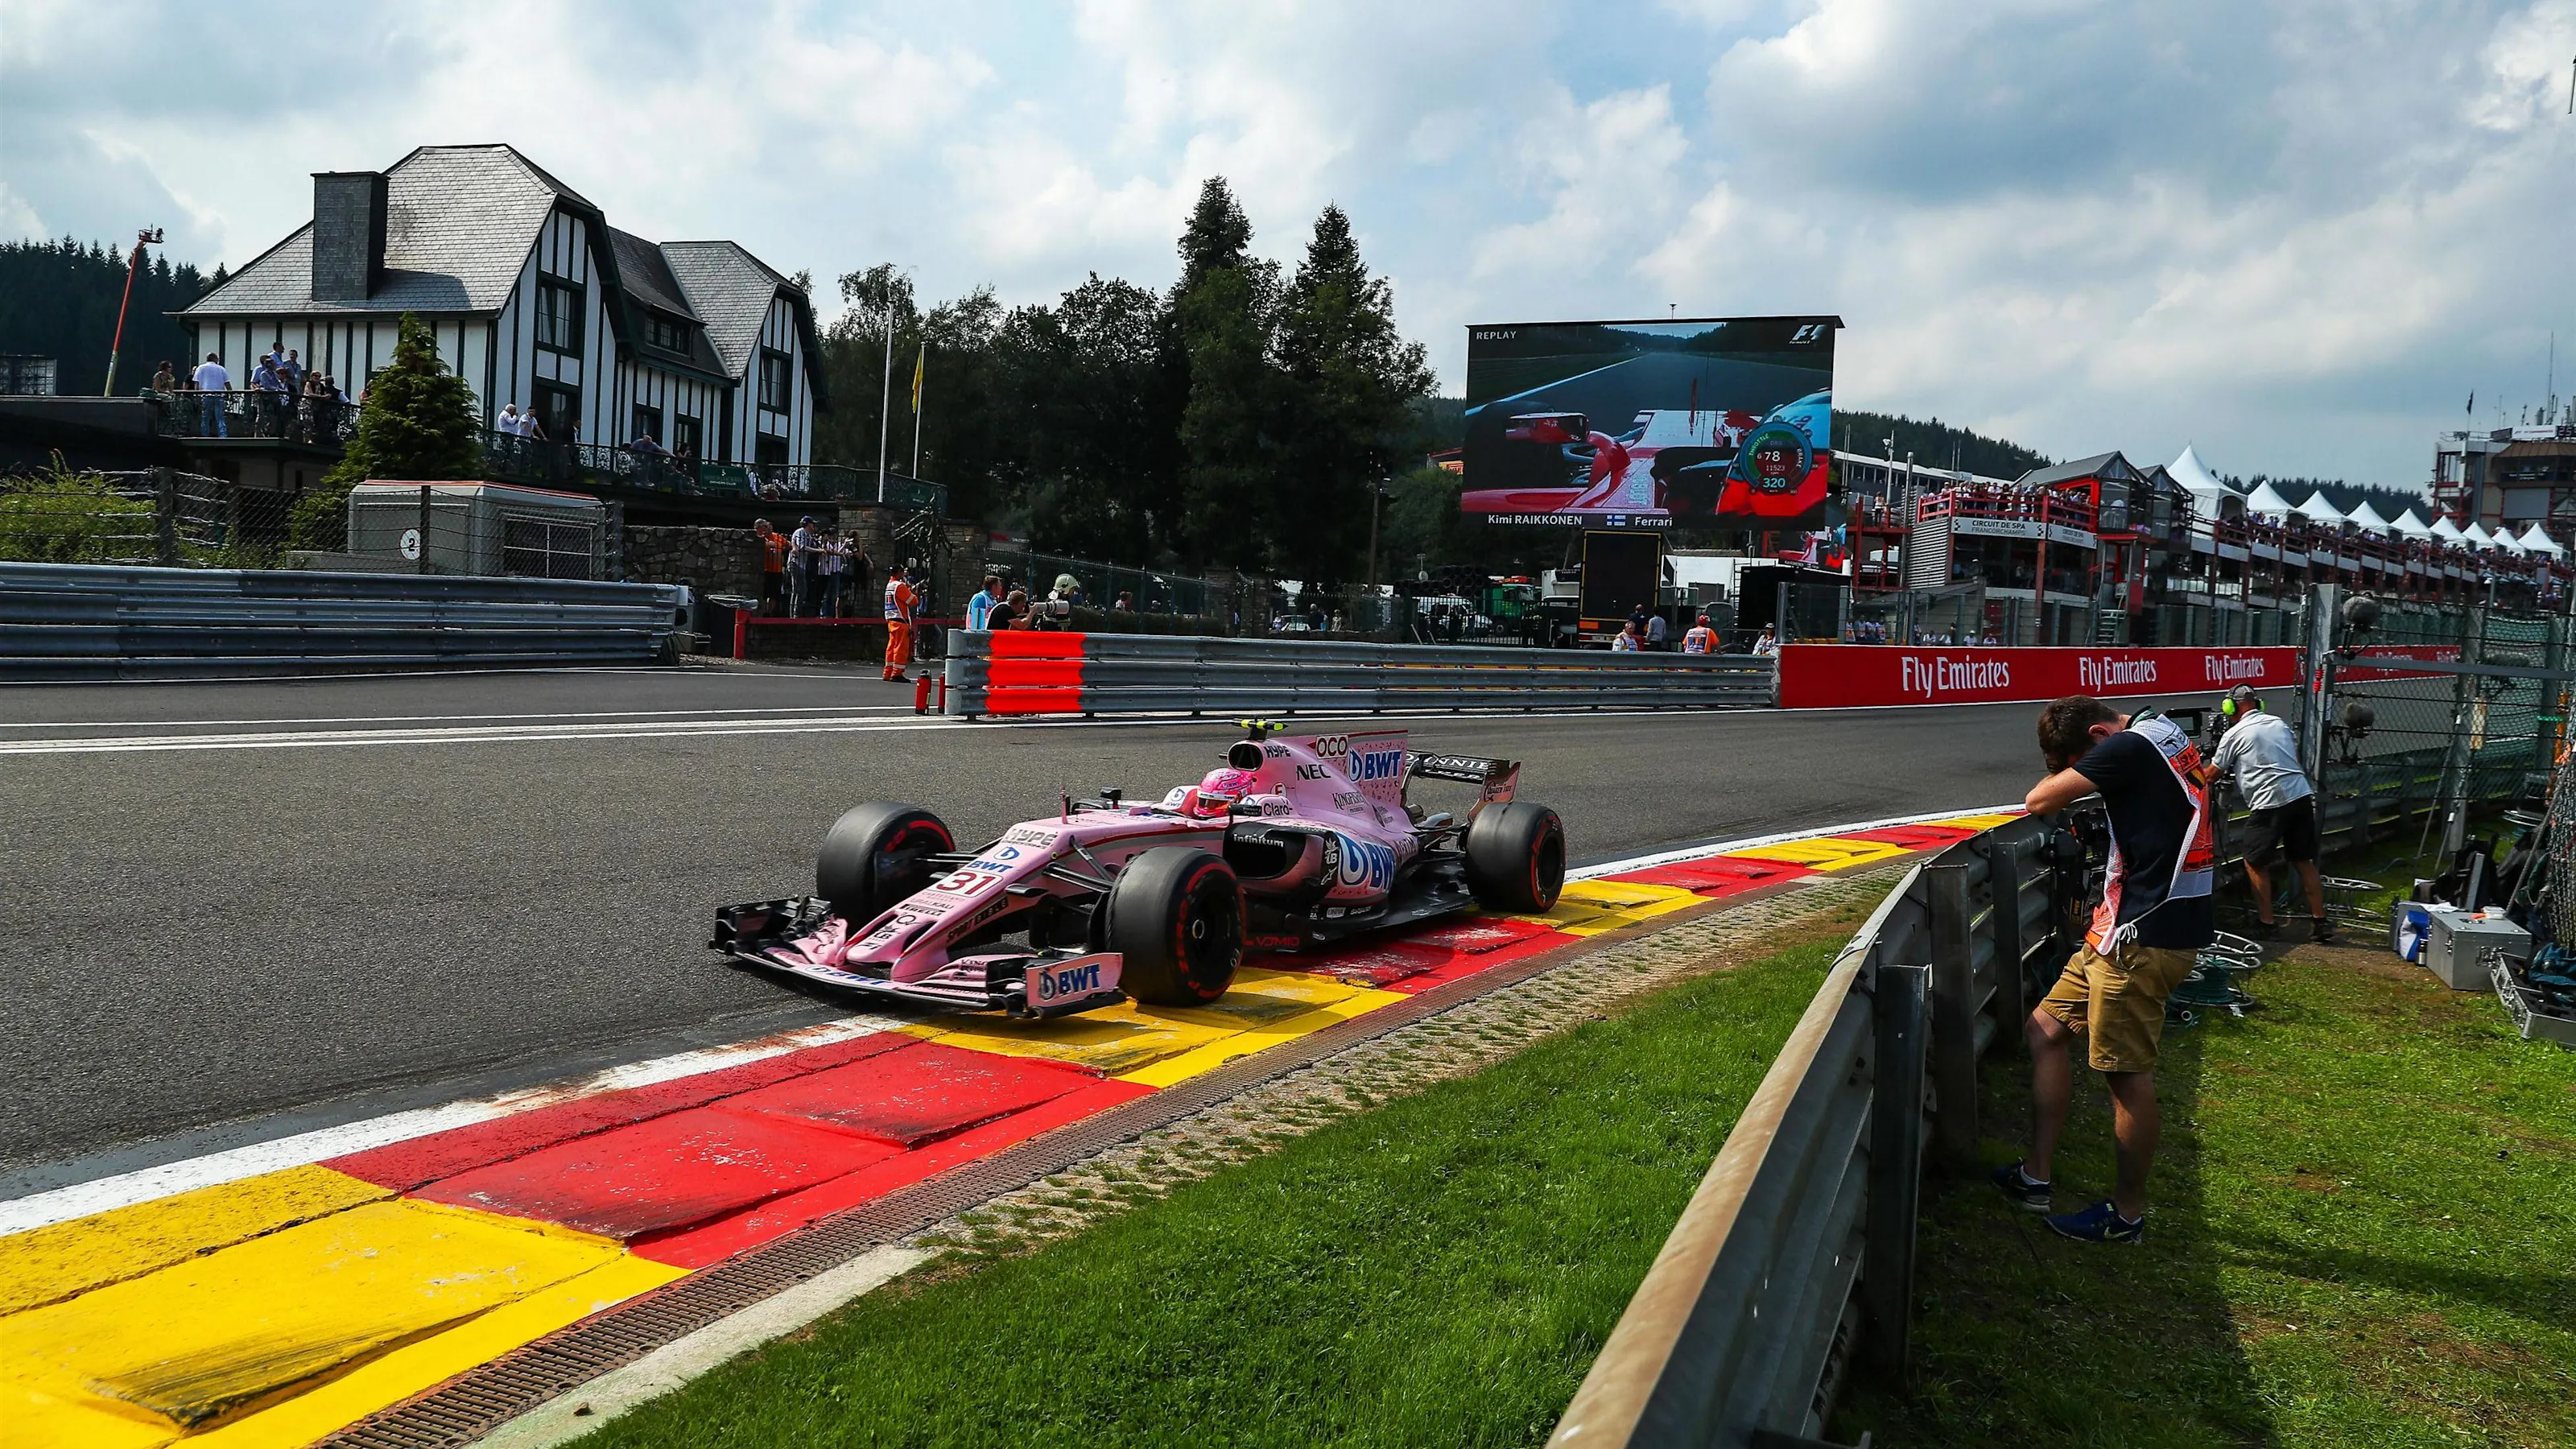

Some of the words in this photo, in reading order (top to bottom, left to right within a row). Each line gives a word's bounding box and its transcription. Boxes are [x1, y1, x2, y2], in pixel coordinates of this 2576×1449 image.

[1476, 331, 1517, 341] REPLAY
[1748, 433, 1770, 456] THROTTLE
[1763, 477, 1785, 488] 320
[1488, 515, 1512, 524] Kimi
[1514, 515, 1583, 526] RAIKKONEN
[1635, 517, 1673, 526] Ferrari
[1972, 520, 2000, 529] CIRCUIT
[1972, 527, 2026, 536] FRANCORCHAMPS
[408, 538, 415, 552] 2
[1901, 656, 1933, 699] Fly
[1936, 654, 2010, 690] Emirates
[2079, 657, 2101, 692] Fly
[2103, 654, 2157, 685] Emirates
[2205, 654, 2222, 686] Fly
[2223, 653, 2264, 679] Emirates
[1264, 745, 1290, 758] HYPE
[1317, 737, 1348, 757] OCO
[1296, 764, 1331, 781] NEC
[1364, 750, 1402, 780] BWT
[1005, 828, 1059, 846] HYPE
[1233, 833, 1285, 848] infinitum
[968, 860, 1013, 873] BWT
[936, 872, 996, 895] 31
[1059, 964, 1100, 996] BWT
